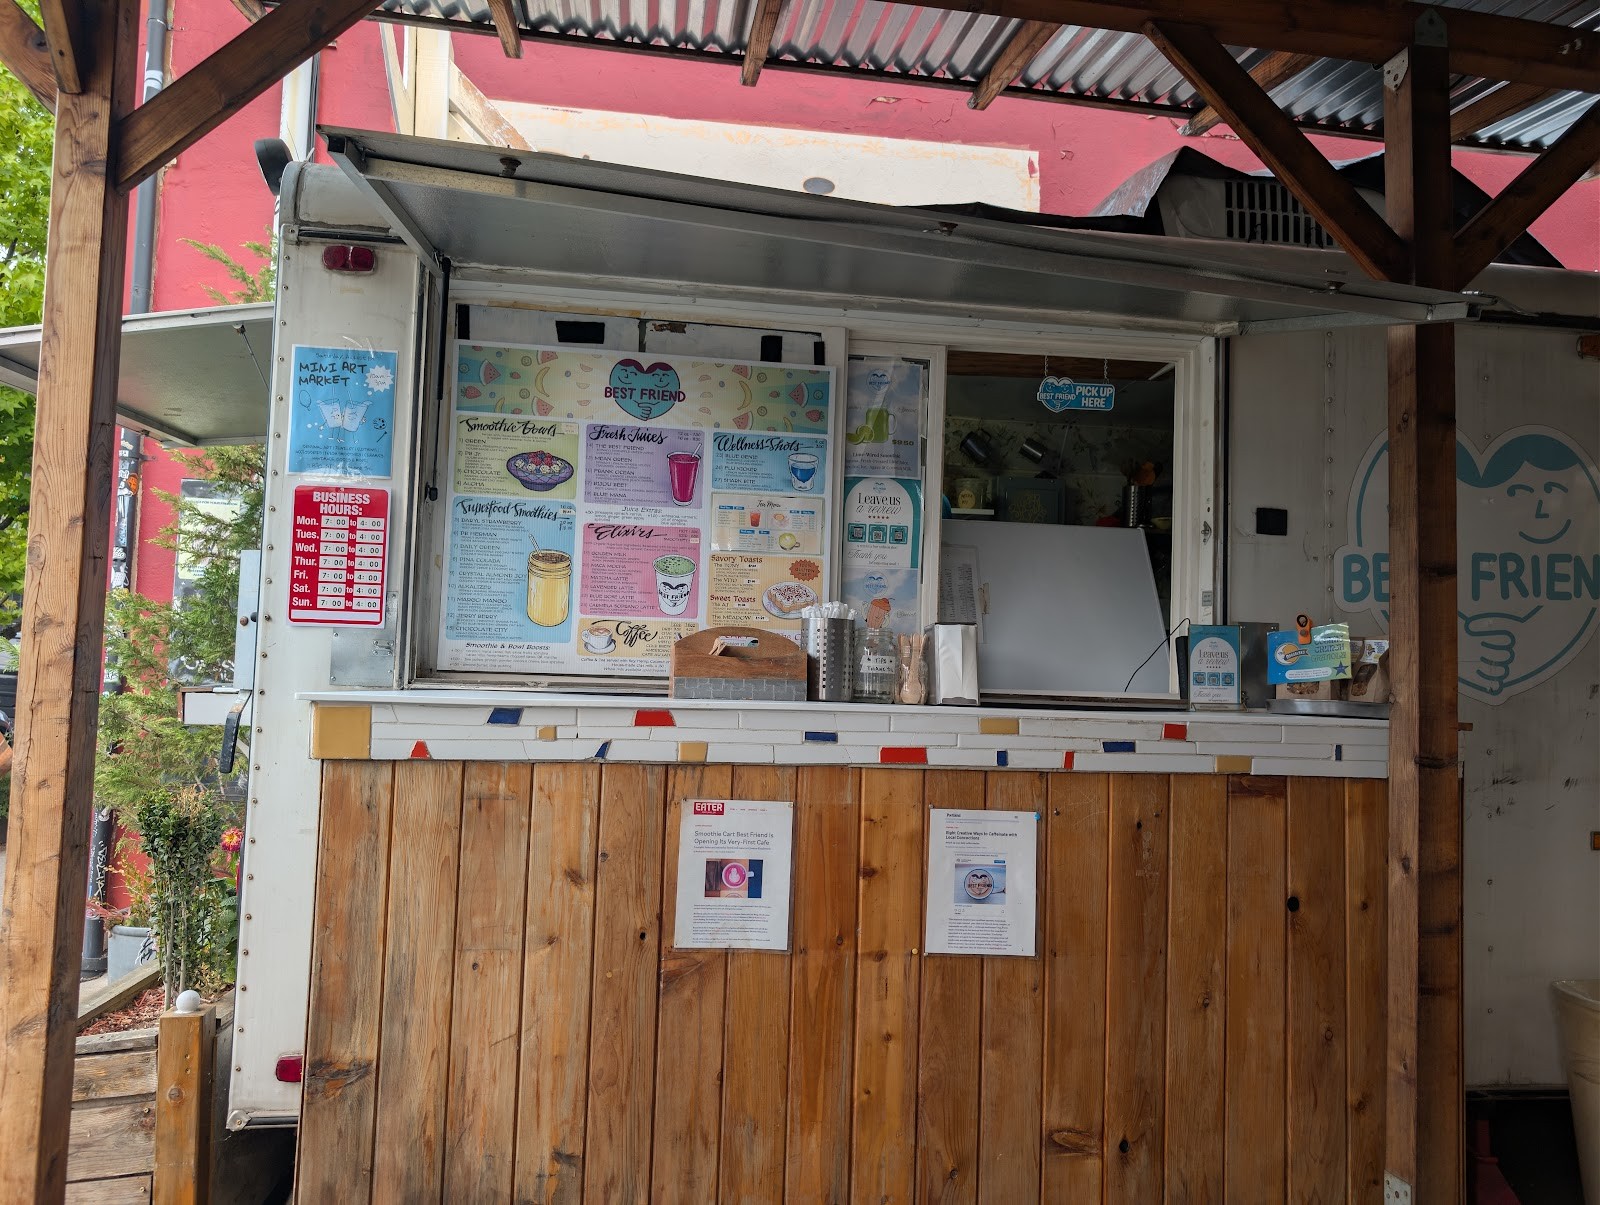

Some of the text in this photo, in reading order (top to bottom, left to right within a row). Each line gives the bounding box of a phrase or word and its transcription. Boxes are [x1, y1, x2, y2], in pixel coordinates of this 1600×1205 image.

[299, 361, 368, 374] MINI ART
[298, 373, 351, 387] MARKET
[604, 386, 687, 403] BEST FRIEND
[1054, 393, 1077, 401] FRIEND
[1075, 386, 1114, 398] PICK UP
[1081, 397, 1107, 408] HERE
[459, 417, 519, 433] Smoothie
[518, 420, 562, 437] Bowls
[588, 424, 628, 441] Fresh
[627, 427, 669, 445] Juices
[713, 434, 801, 452] Wellness Shots
[312, 491, 371, 505] BUSINESS
[858, 492, 901, 506] Leave us
[319, 503, 363, 515] HOURS:
[455, 498, 559, 521] Superfood Smoothies
[866, 505, 903, 516] review
[296, 516, 319, 526] Mon.
[295, 529, 320, 539] Tues.
[588, 523, 657, 541] Elixirs
[294, 543, 318, 553] Wed.
[294, 556, 318, 566] Thur.
[711, 554, 764, 564] Savory Toasts
[847, 549, 888, 563] Thank you
[293, 570, 309, 579] Fri.
[1342, 552, 1600, 603] BE FRIEN
[292, 584, 311, 593] Sat.
[291, 598, 313, 606] Sun.
[709, 594, 757, 603] Sweet Toasts
[602, 619, 658, 648] Coffee
[465, 642, 498, 650] Smoothie
[1199, 649, 1229, 659] Leave us
[1310, 651, 1347, 662] GRANOLA
[695, 802, 723, 812] EATER
[694, 838, 719, 846] Opening
